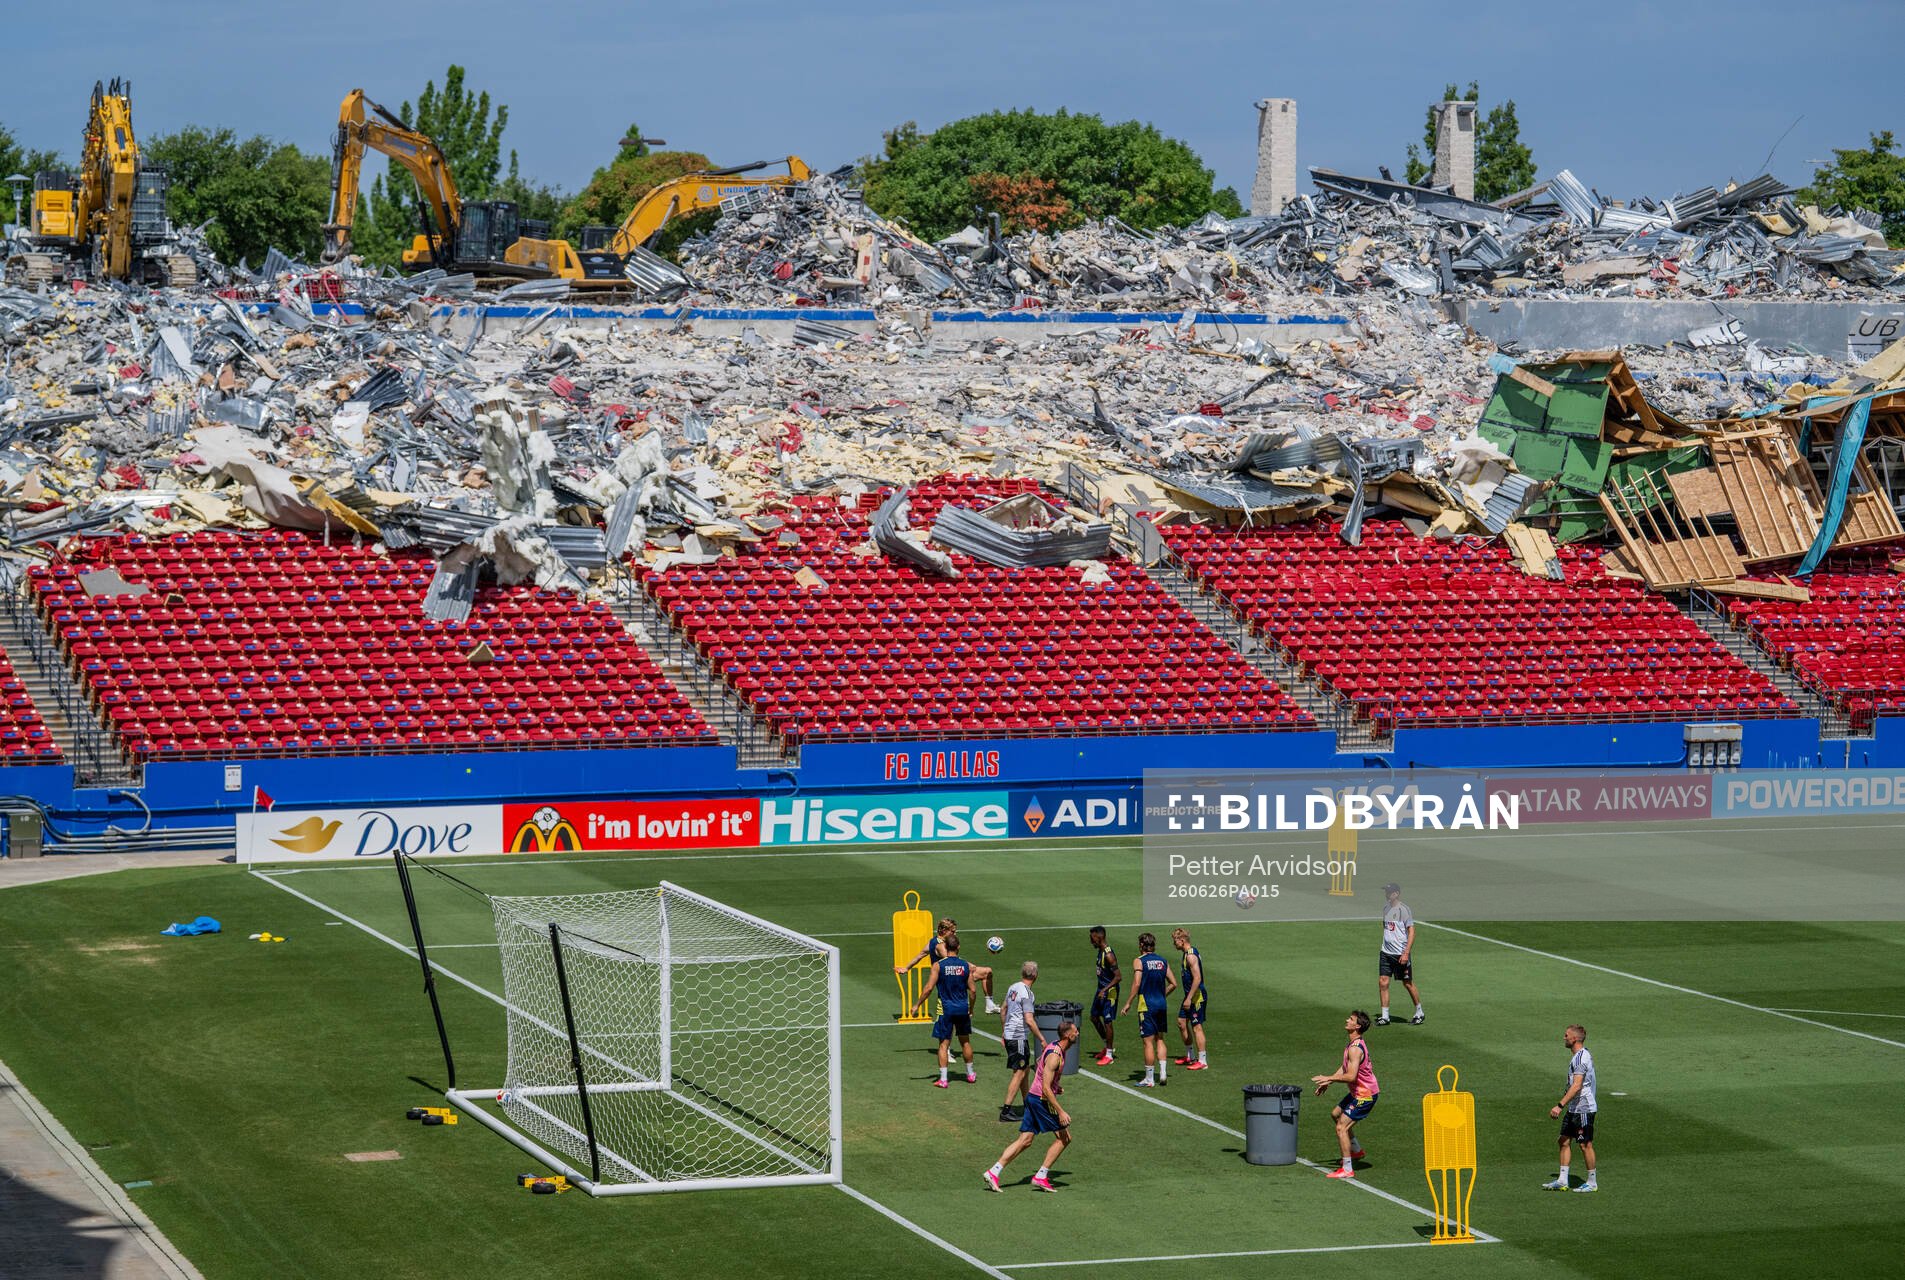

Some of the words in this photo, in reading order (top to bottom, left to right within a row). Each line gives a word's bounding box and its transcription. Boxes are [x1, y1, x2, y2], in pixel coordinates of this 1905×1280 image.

[885, 753, 910, 780] FC
[920, 750, 1000, 779] DALLAS
[1493, 788, 1583, 812] QATAR
[1594, 784, 1707, 811] AIRWAYS
[1727, 776, 1905, 810] POWERADE
[760, 799, 1009, 843] Hisense
[1050, 798, 1128, 828] ADI
[1145, 804, 1235, 817] PREDICTSTRE
[354, 810, 473, 856] Dove
